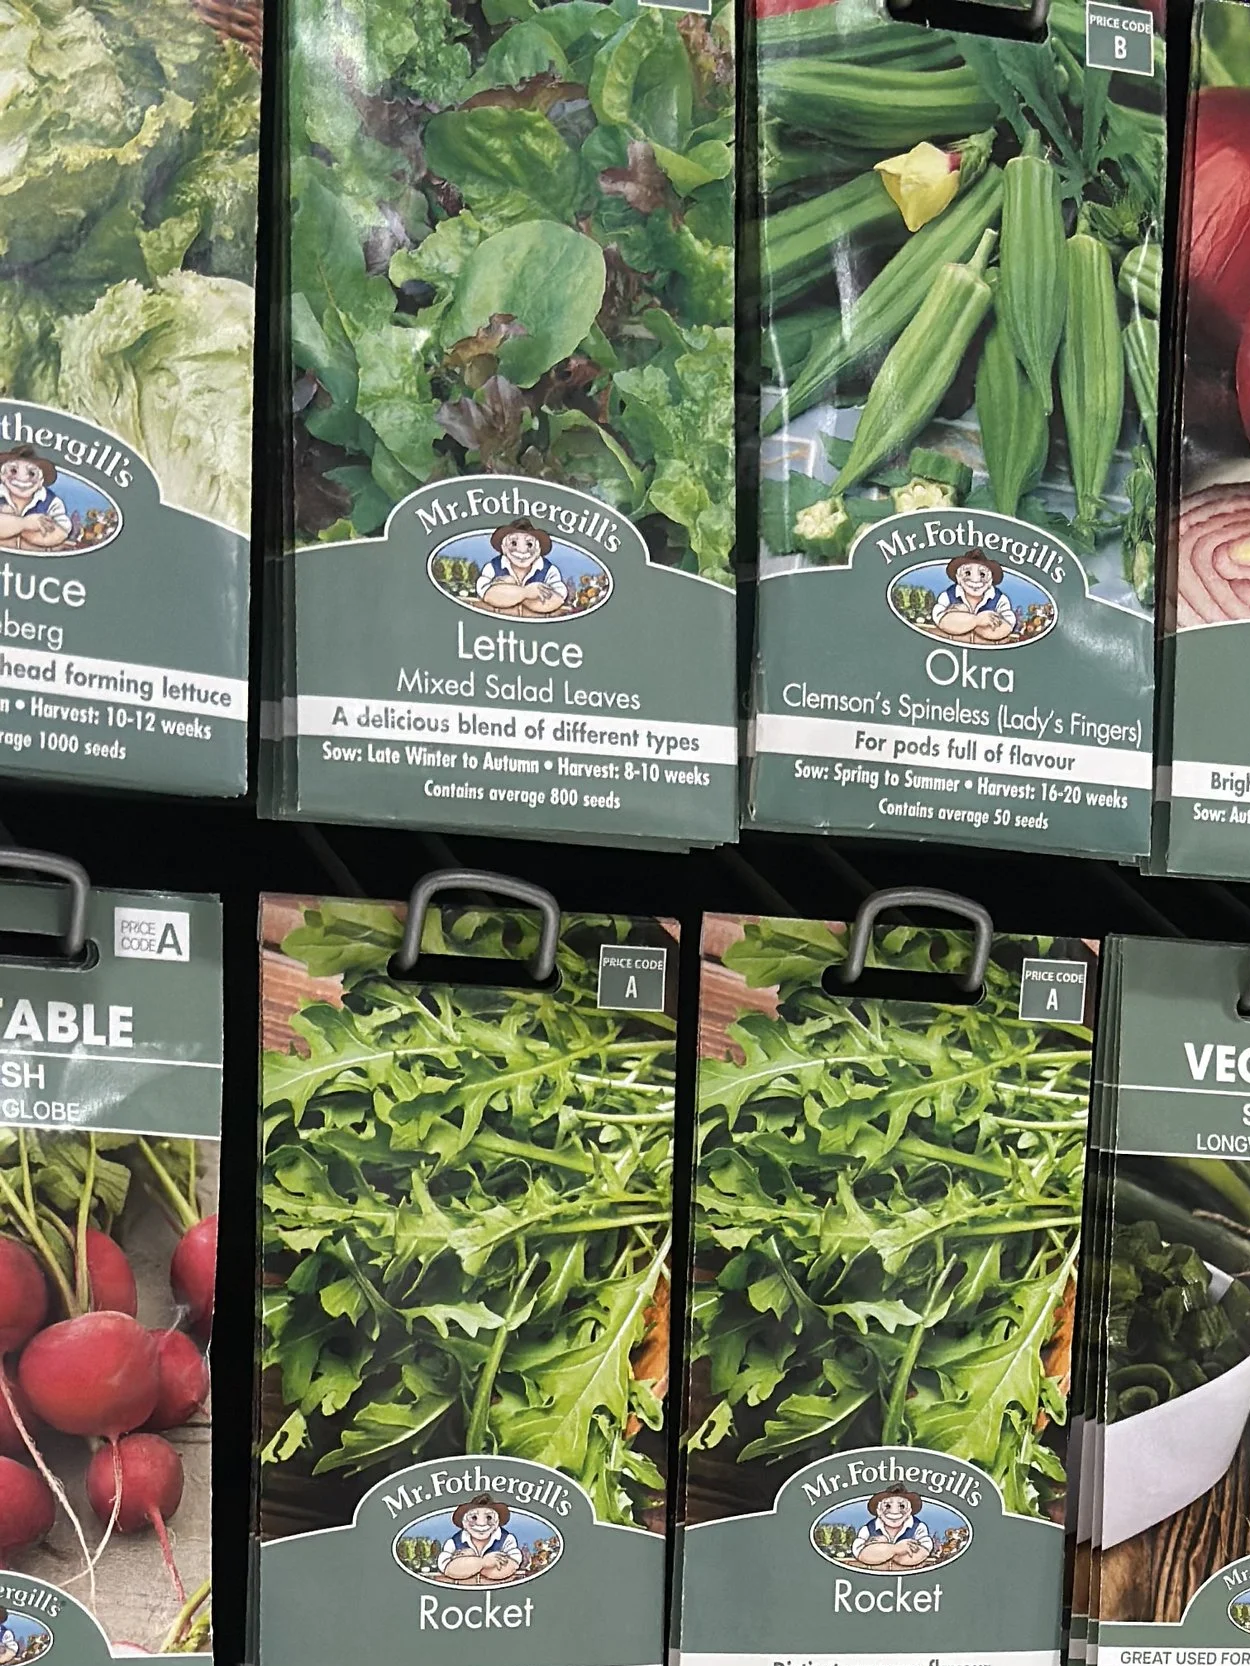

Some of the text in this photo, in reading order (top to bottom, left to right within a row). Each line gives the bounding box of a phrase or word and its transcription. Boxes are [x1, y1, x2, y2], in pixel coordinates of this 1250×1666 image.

[458, 621, 583, 669] Lettuce
[65, 662, 232, 707] forming lettuce
[397, 668, 640, 711] Mixed Salad Leaves
[926, 648, 1014, 692] Okra
[332, 706, 700, 755] A delicious blend of different types
[783, 682, 1142, 748] Clemson's Spineless (Lady's Fingers)
[156, 923, 182, 956] A
[2, 1099, 81, 1122] GLOBE
[420, 1591, 534, 1630] Rocket
[835, 1576, 943, 1614] Rocket
[1121, 1651, 1171, 1666] GREAT
[1176, 1651, 1217, 1666] USED
[1221, 1651, 1250, 1666] FOR
